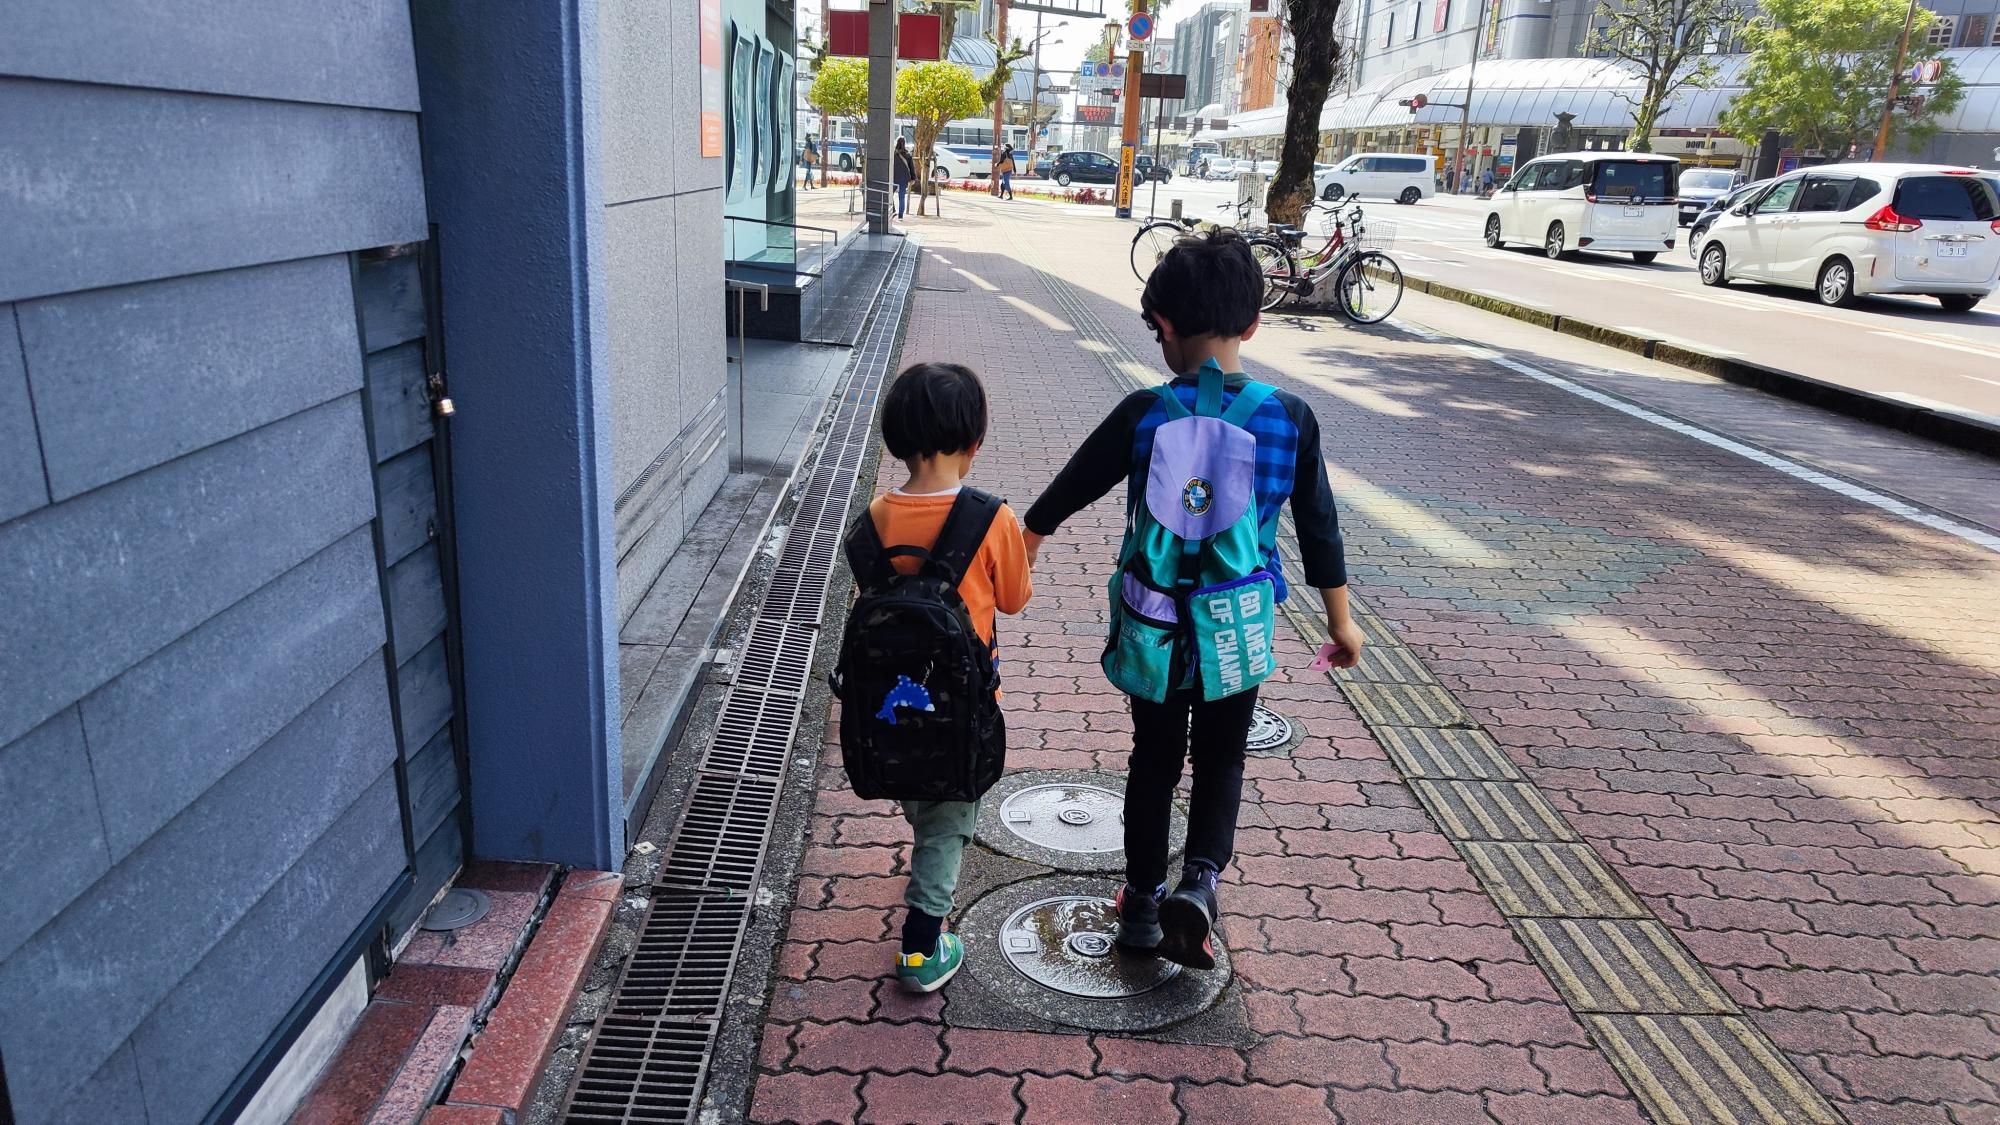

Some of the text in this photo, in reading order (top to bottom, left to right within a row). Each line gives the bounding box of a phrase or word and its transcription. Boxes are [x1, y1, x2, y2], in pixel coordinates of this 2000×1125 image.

[1209, 598, 1242, 696] OF CHAMP!!
[1238, 590, 1268, 676] GO AHEAD
